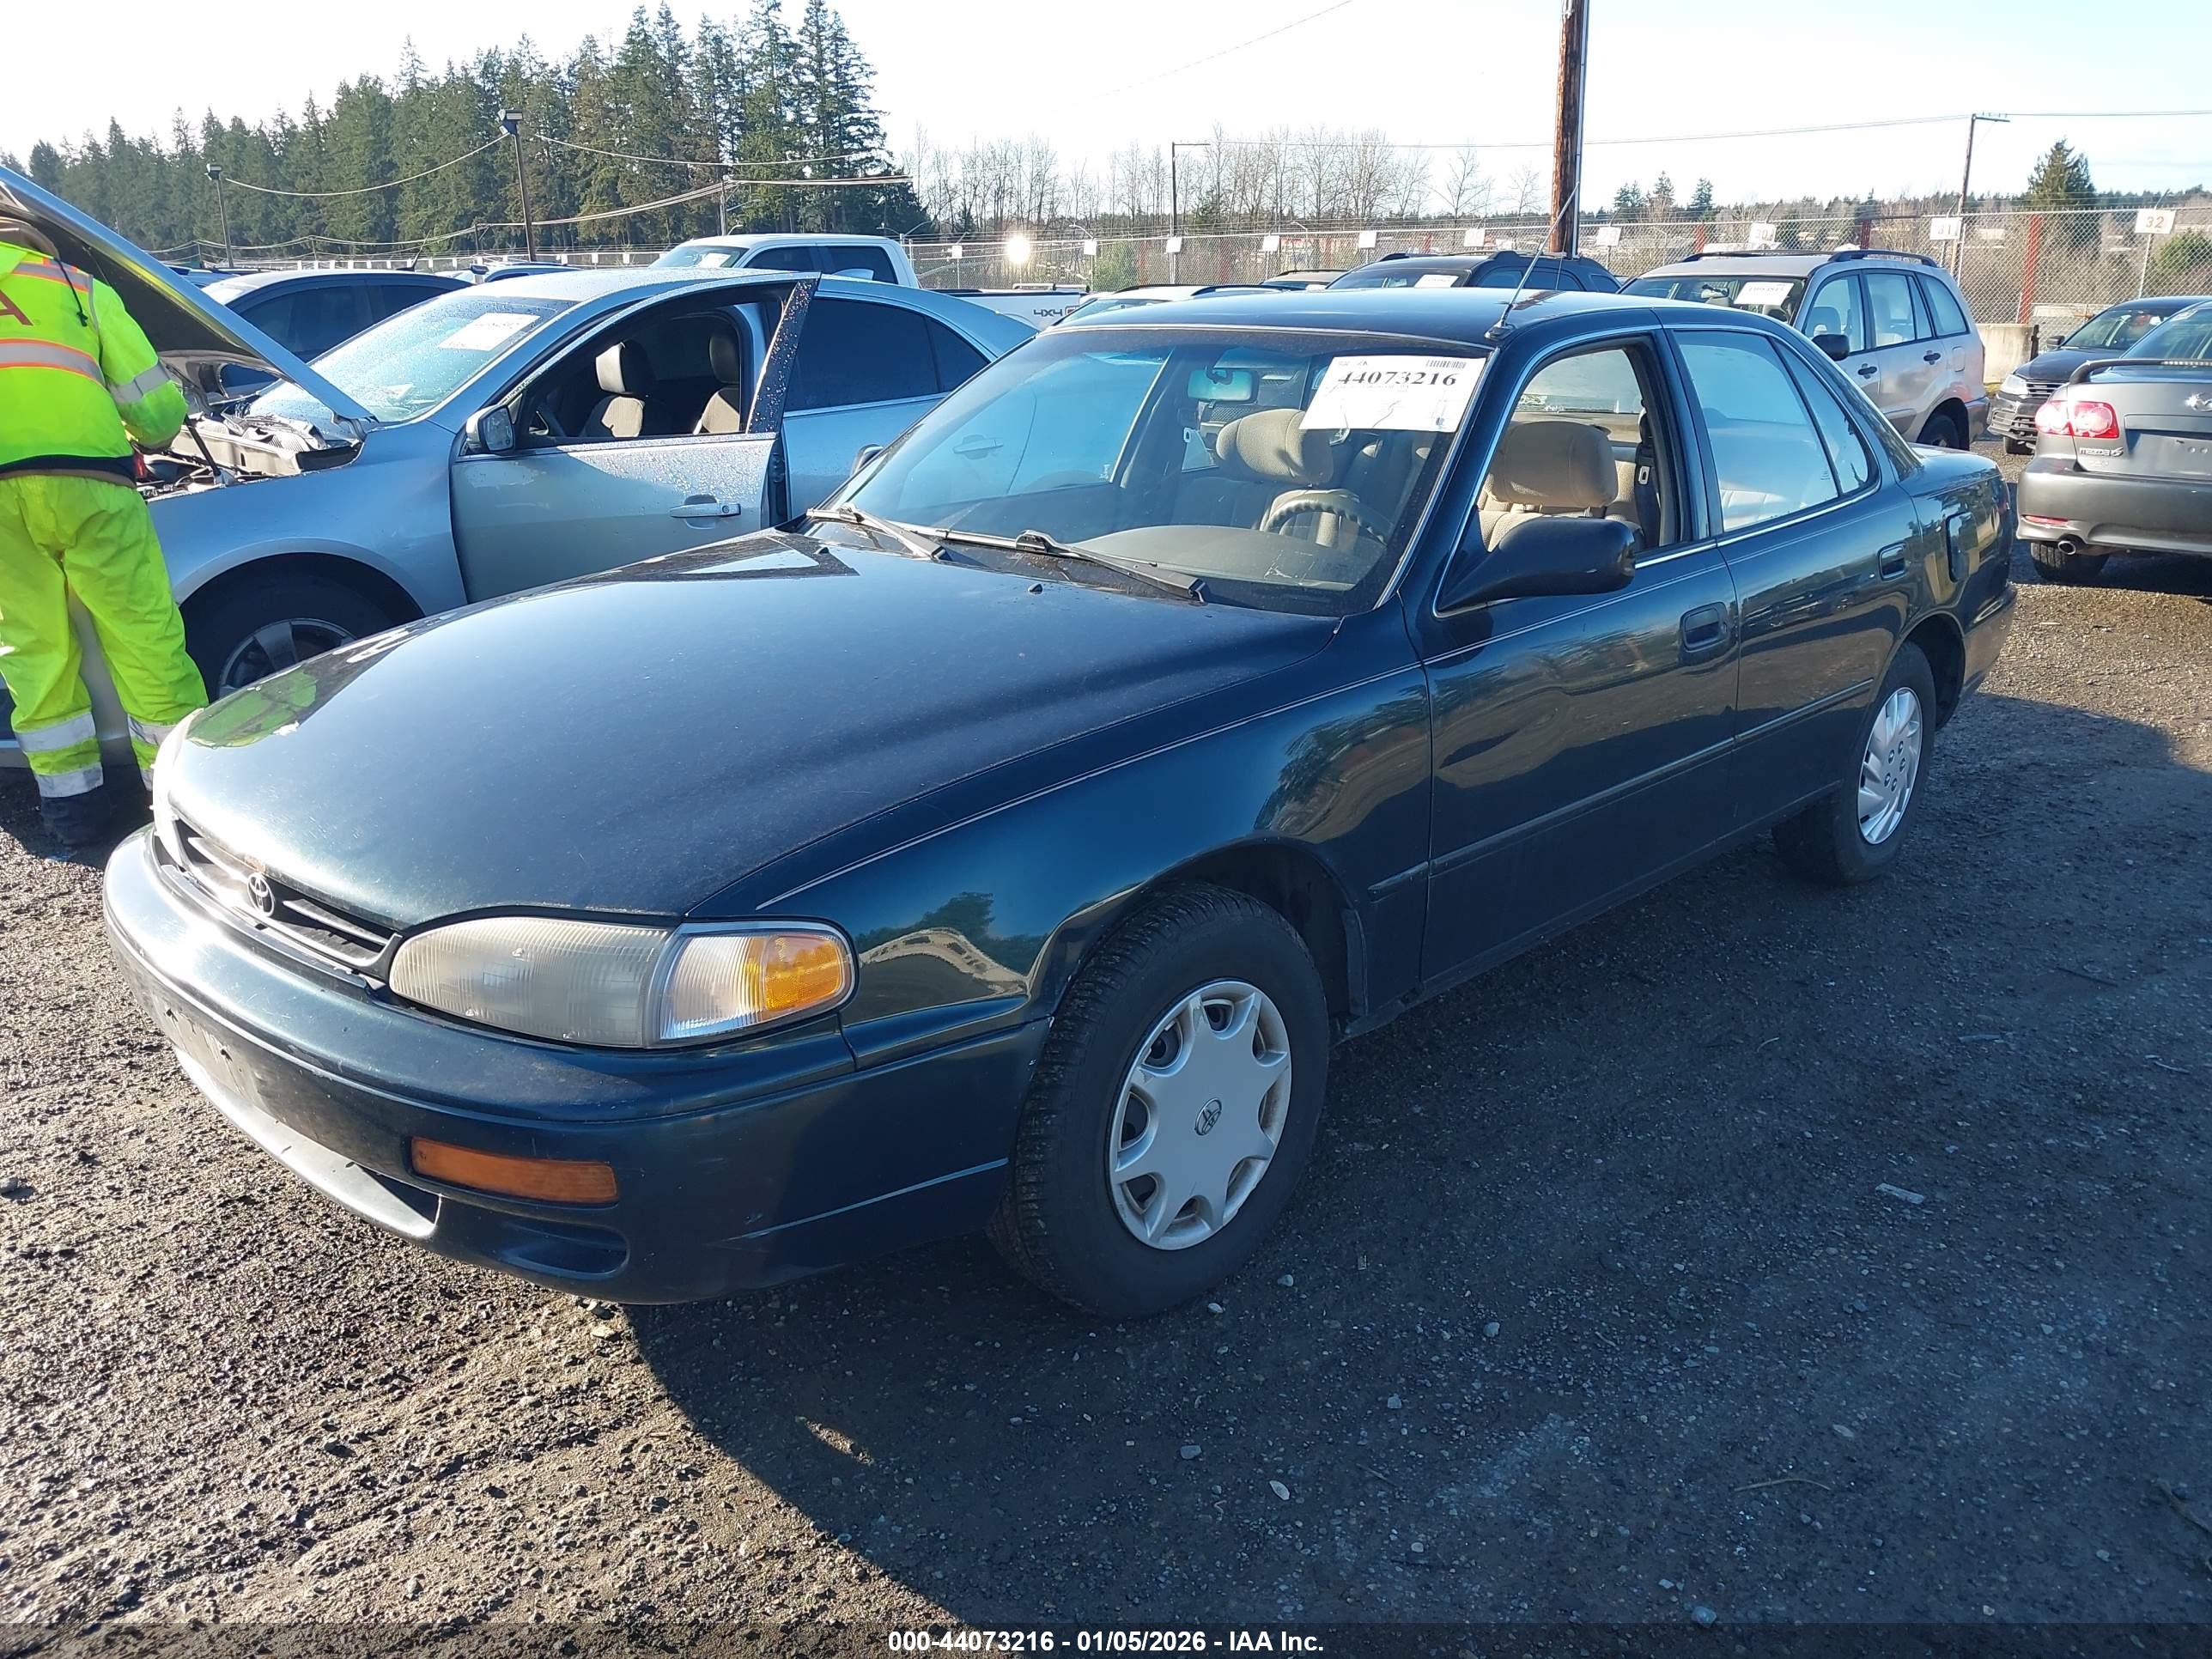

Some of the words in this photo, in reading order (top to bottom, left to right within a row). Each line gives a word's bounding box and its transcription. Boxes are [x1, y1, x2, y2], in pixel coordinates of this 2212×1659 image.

[2145, 216, 2165, 228] 32
[1937, 224, 1952, 234] 31
[1337, 371, 1459, 386] 44073216
